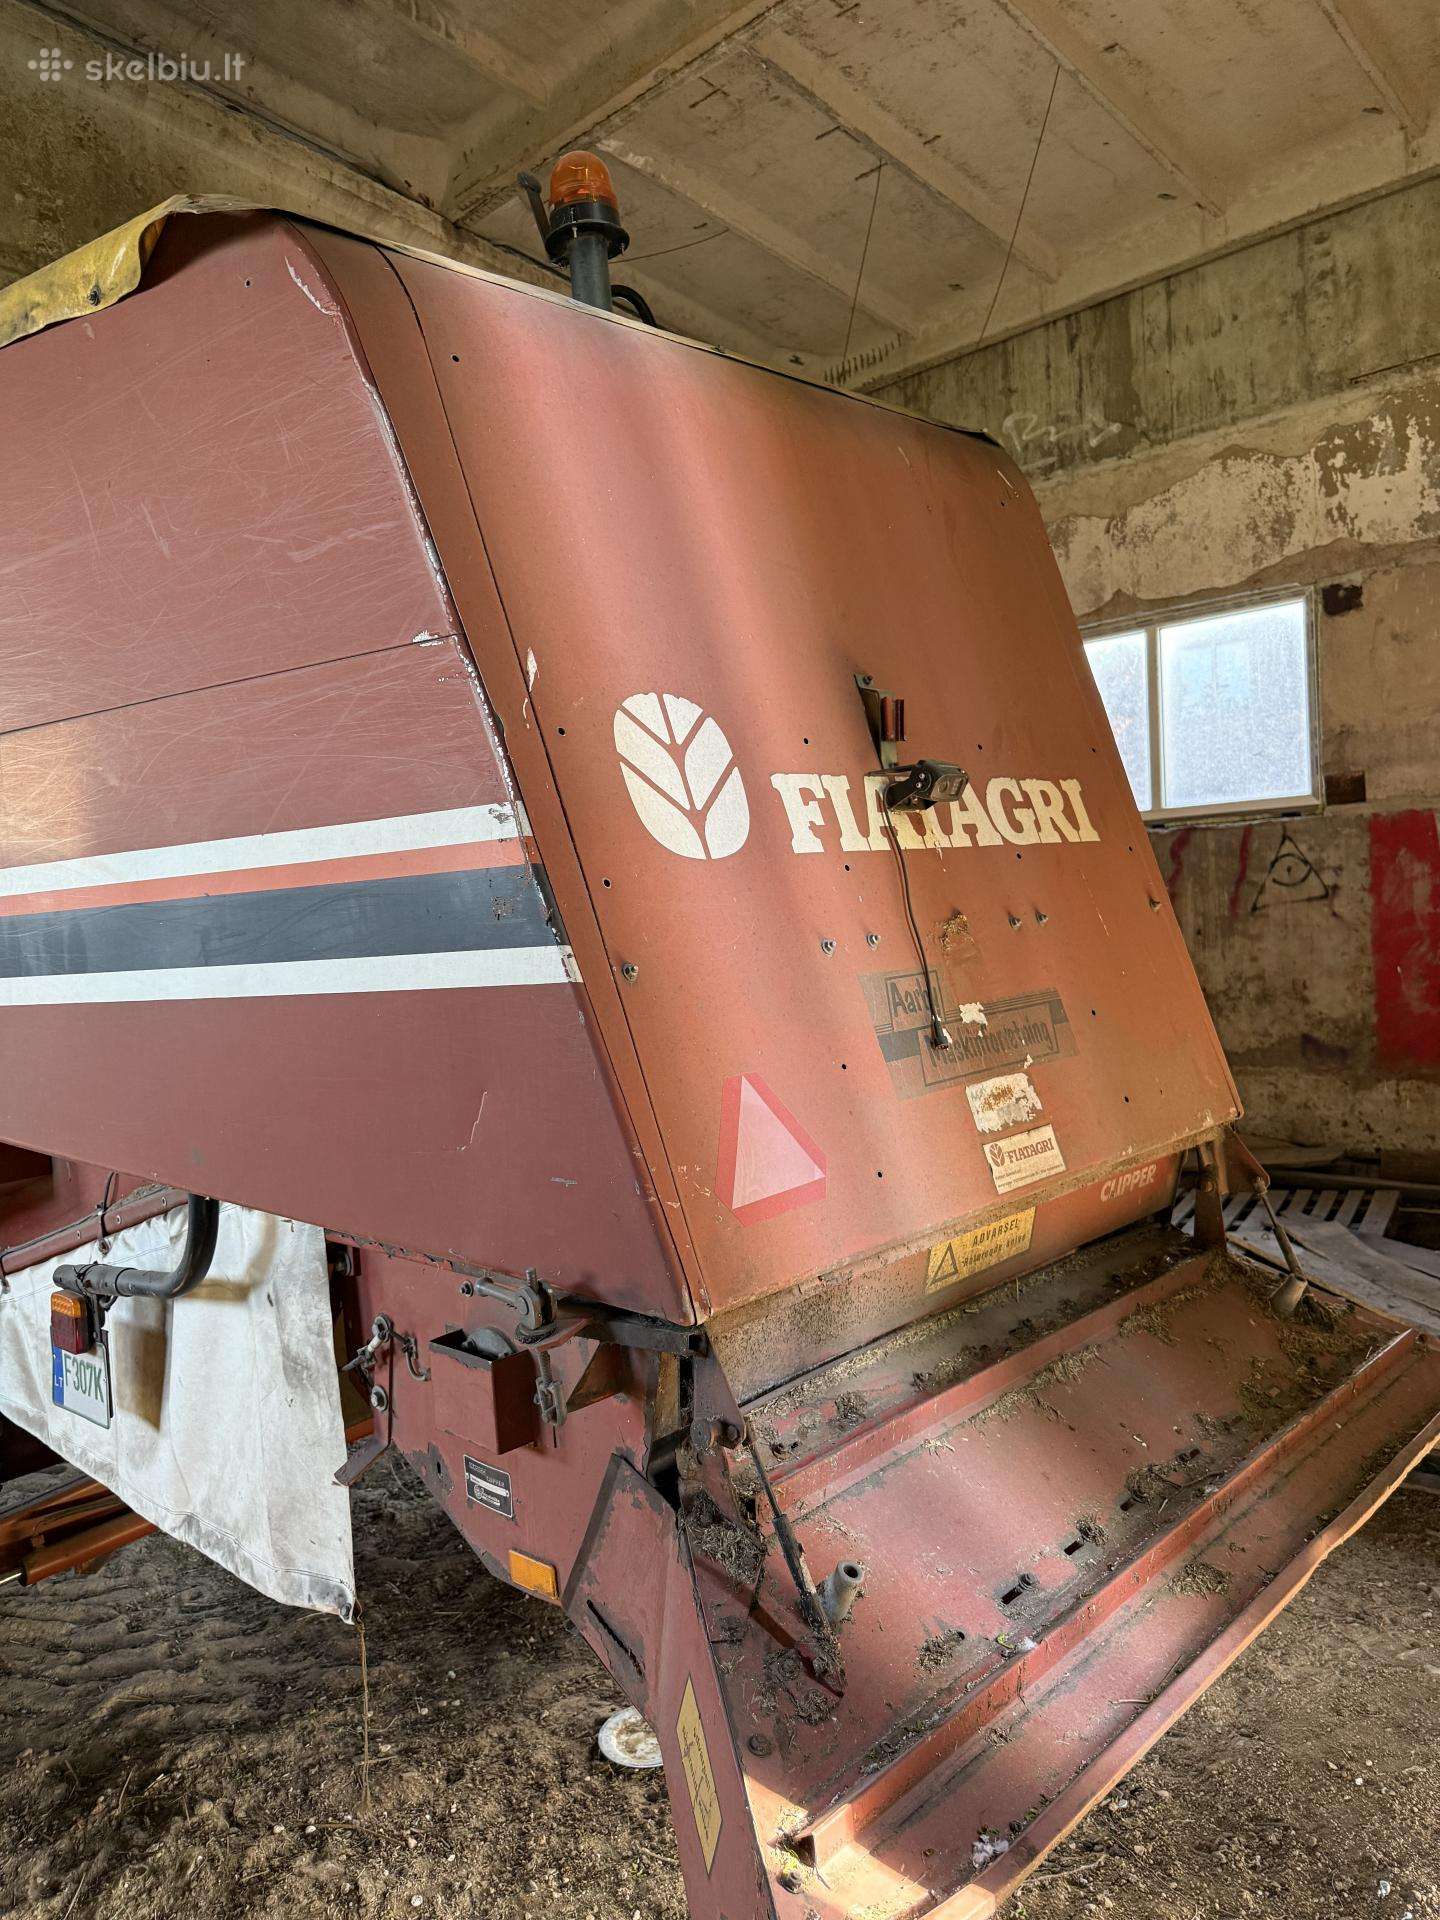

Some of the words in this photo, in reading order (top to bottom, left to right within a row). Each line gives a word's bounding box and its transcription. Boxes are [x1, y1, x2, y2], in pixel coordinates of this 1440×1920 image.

[1006, 1137, 1054, 1164] FIATAGRI
[1100, 1164, 1157, 1202] CLIPPER
[64, 1353, 104, 1403] F307K
